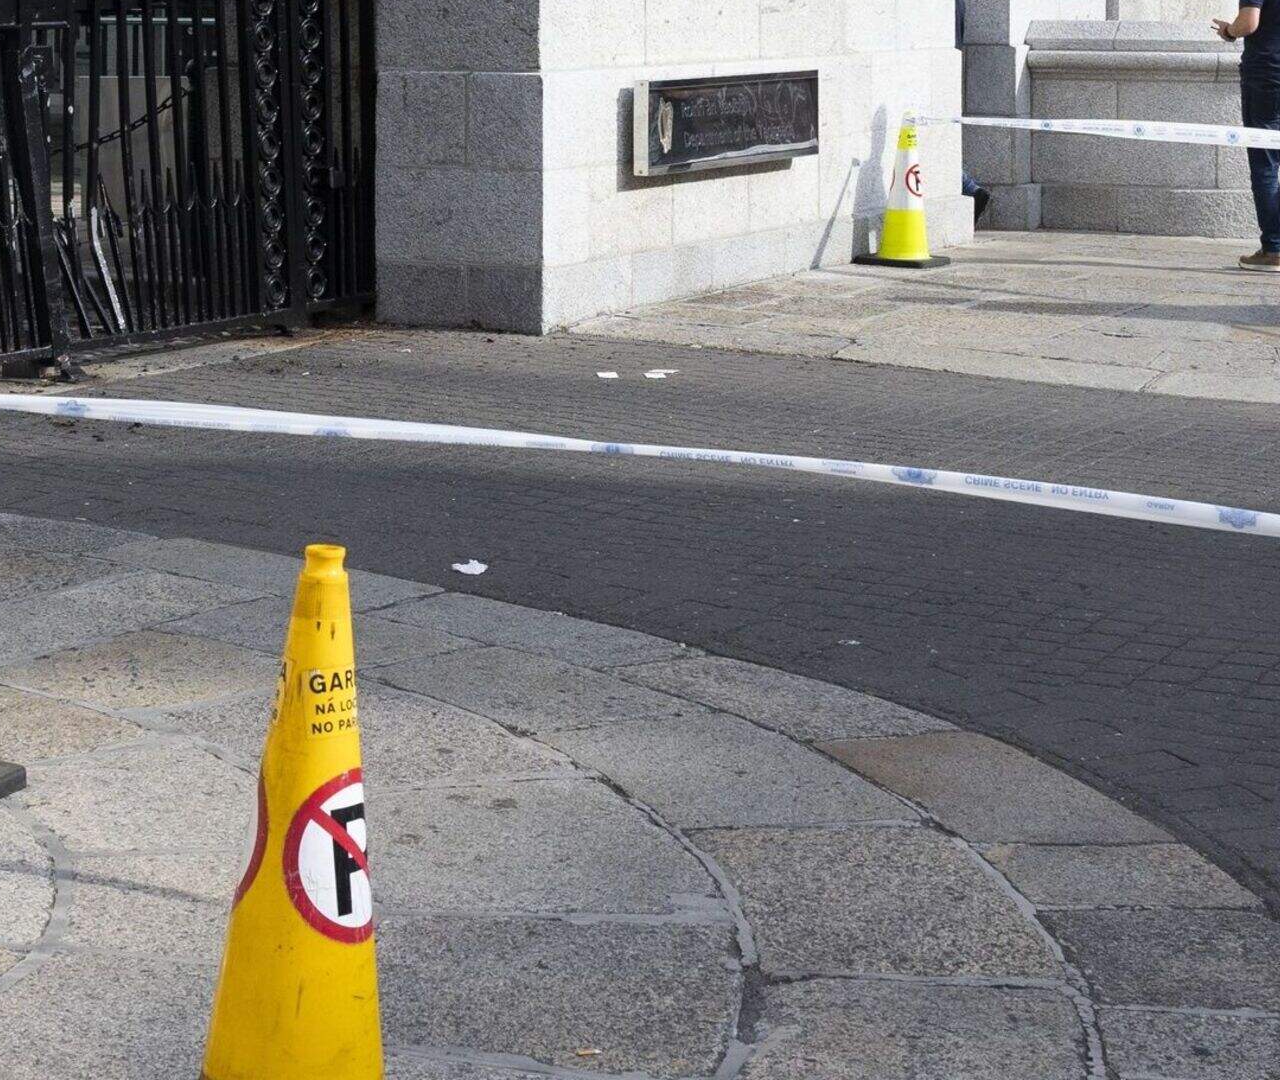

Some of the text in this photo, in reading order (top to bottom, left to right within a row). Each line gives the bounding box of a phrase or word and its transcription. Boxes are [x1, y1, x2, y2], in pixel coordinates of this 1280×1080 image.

[309, 669, 354, 694] GAR
[315, 697, 336, 715] NÁ
[311, 721, 334, 735] NO
